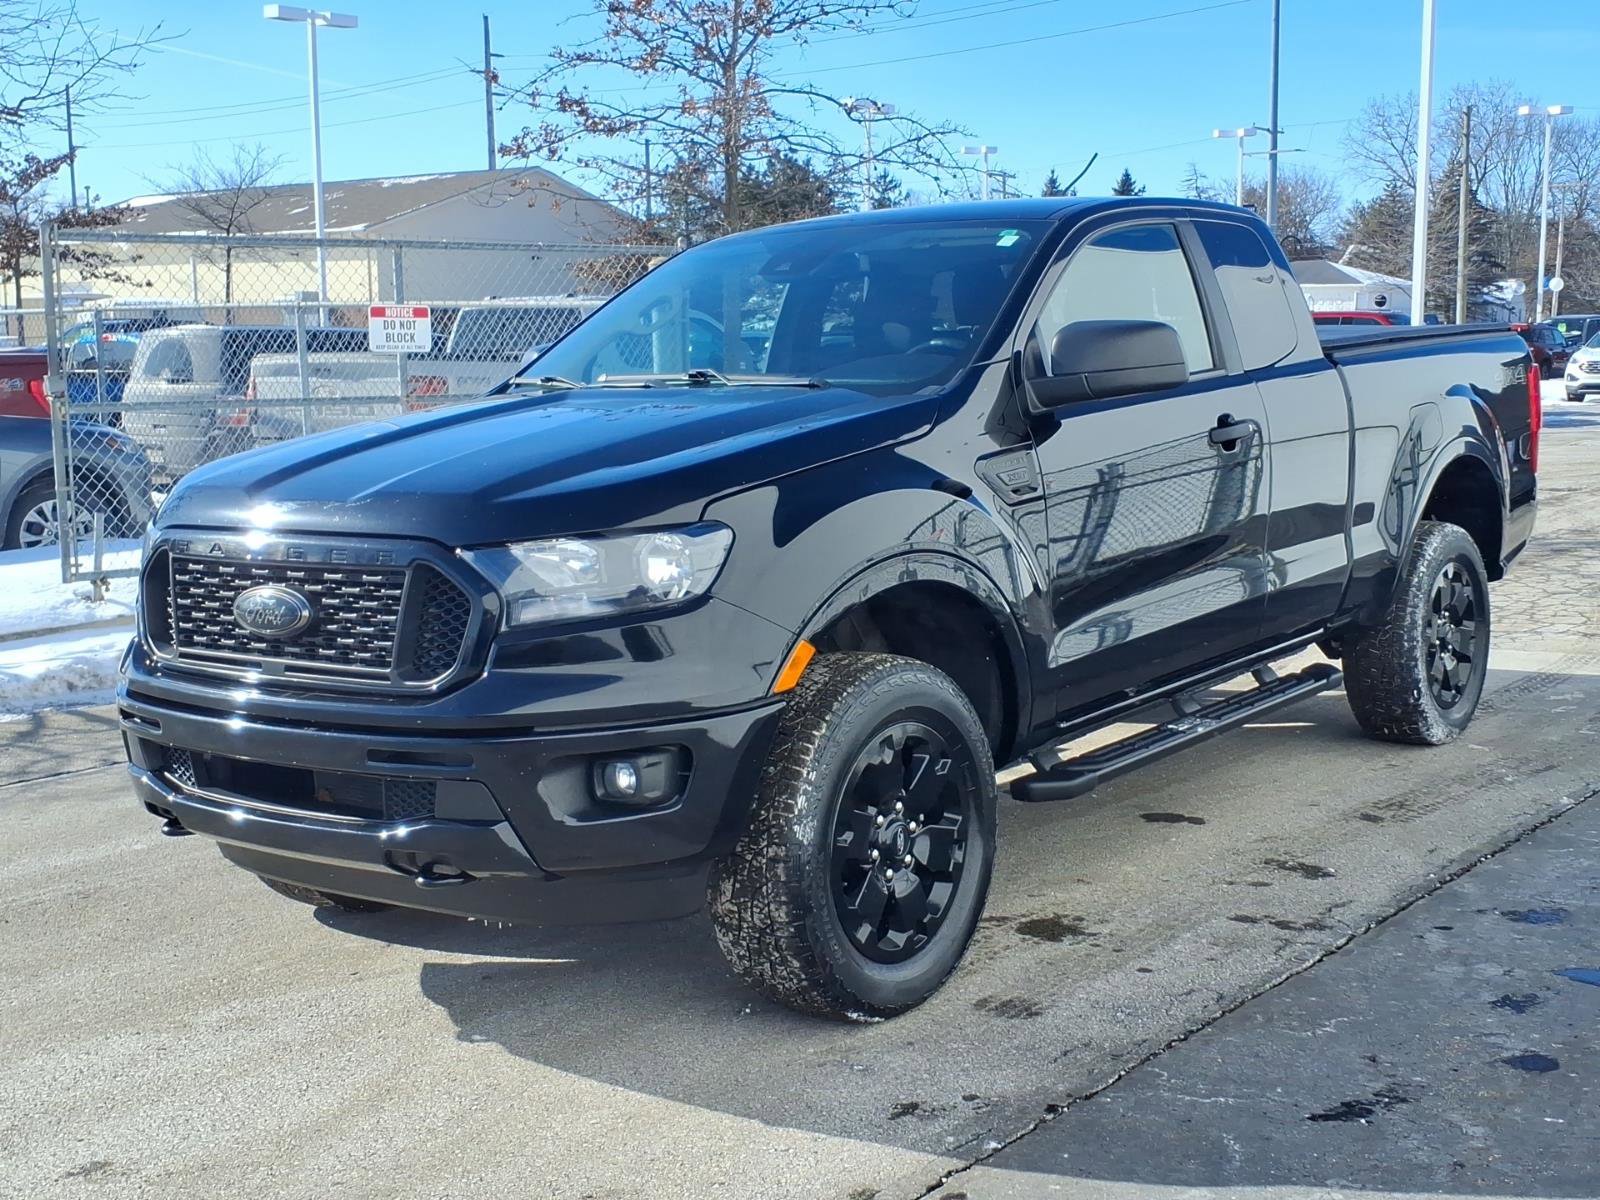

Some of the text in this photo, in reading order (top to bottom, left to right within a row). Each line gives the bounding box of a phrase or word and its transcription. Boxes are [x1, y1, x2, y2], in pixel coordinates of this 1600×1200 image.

[385, 307, 413, 317] NOTICE
[383, 319, 417, 330] DO NOT
[385, 332, 416, 343] BLOCK
[174, 538, 394, 564] RAGER
[244, 599, 286, 625] Ford
